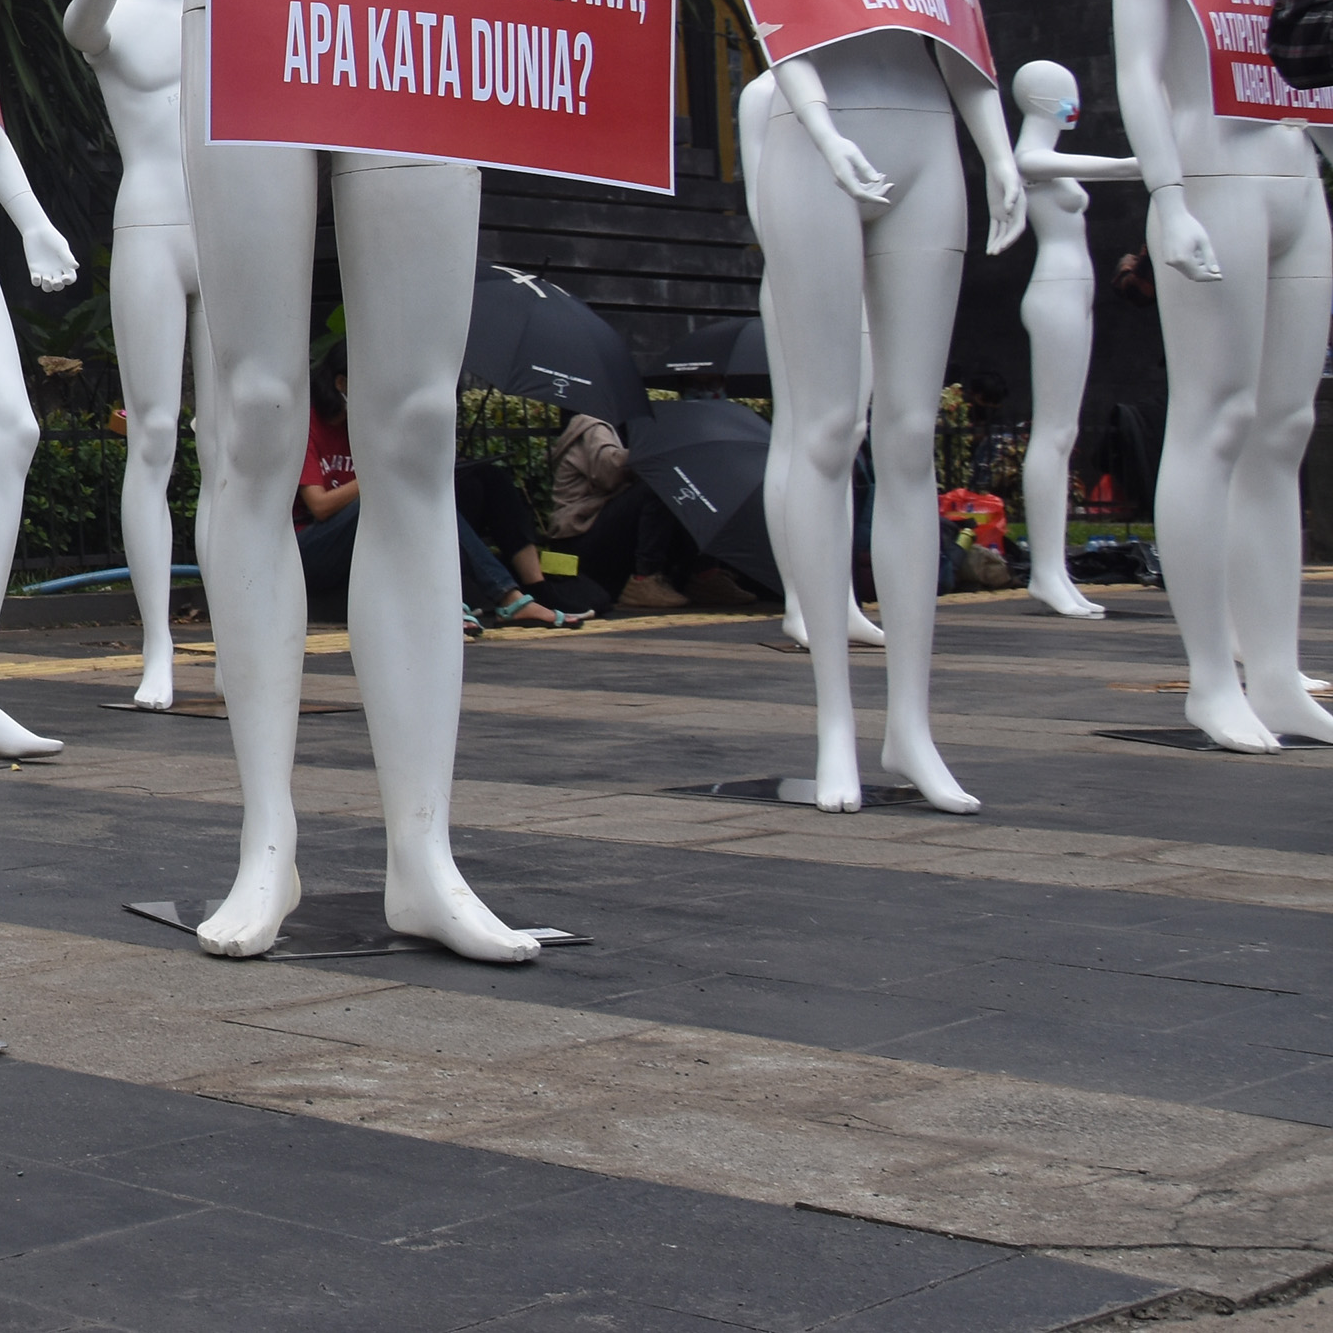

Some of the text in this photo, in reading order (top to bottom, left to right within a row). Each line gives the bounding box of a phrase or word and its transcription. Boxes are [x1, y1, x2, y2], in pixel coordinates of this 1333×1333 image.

[283, 0, 594, 116] APA KATA DUNIA?
[1231, 62, 1272, 104] WARGA
